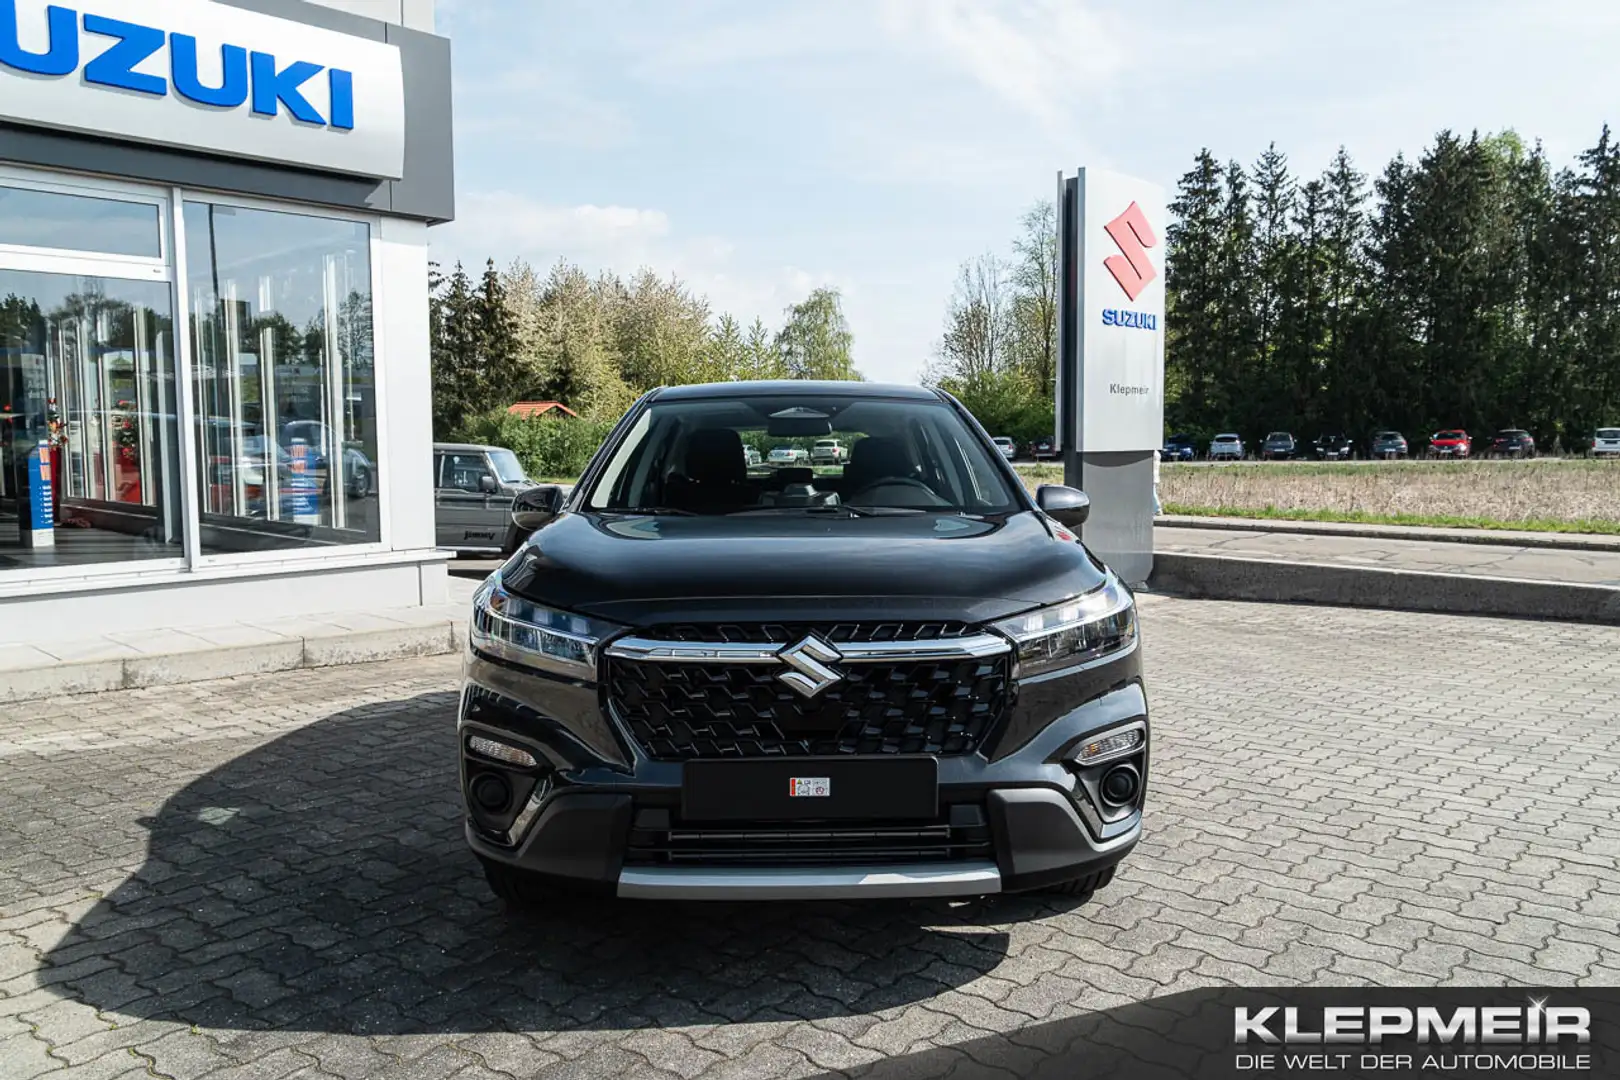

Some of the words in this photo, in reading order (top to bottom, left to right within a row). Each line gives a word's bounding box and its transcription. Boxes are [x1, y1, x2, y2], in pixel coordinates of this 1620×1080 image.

[0, 0, 354, 130] UZUKI
[1102, 308, 1156, 330] SUZUKI
[1109, 383, 1149, 396] Klepmeir
